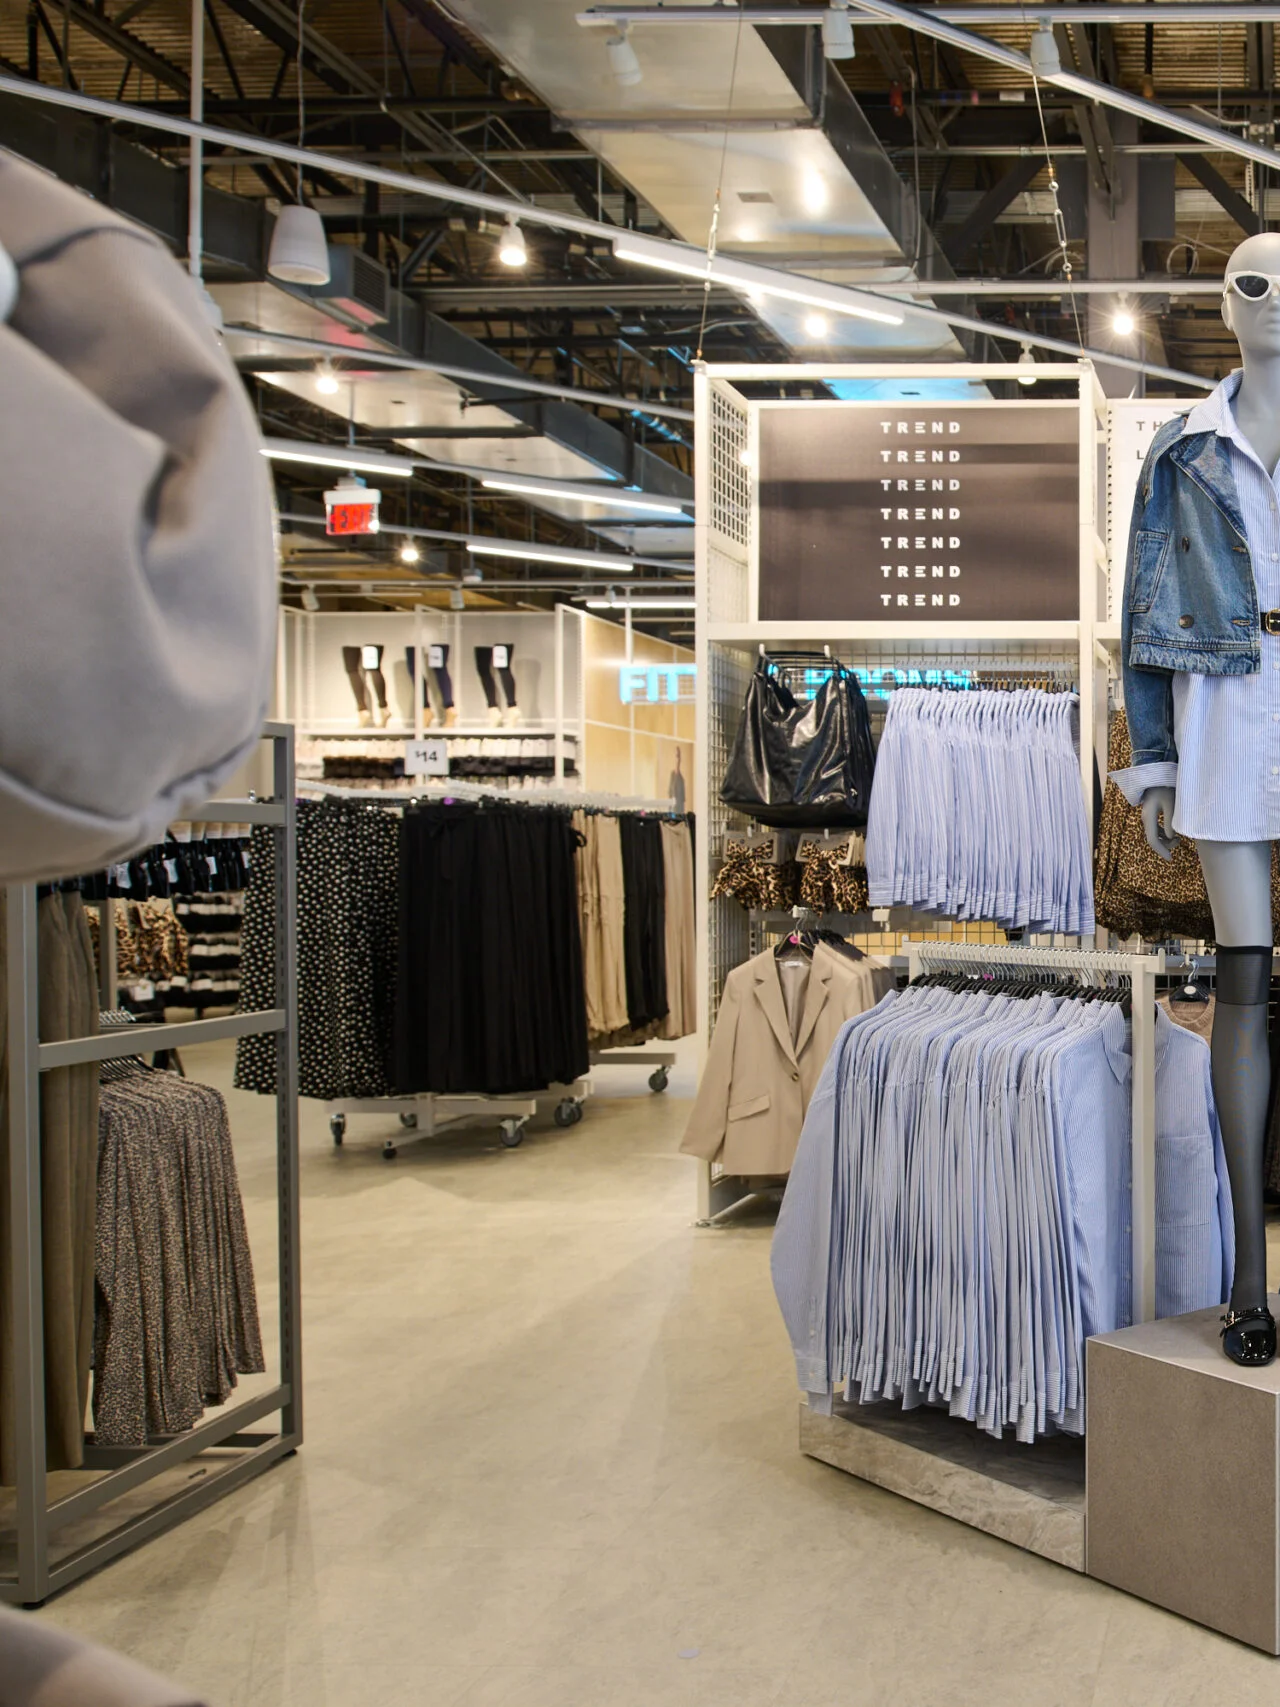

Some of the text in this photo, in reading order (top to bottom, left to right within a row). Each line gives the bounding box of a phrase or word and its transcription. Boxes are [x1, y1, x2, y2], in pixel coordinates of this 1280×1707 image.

[880, 421, 961, 434] TREND
[880, 450, 961, 463] TREND
[880, 479, 961, 492] TREND
[880, 507, 961, 520] TREND
[880, 536, 961, 549] TREND
[880, 565, 961, 578] TREND
[880, 594, 961, 607] TREND
[415, 751, 438, 763] $14
